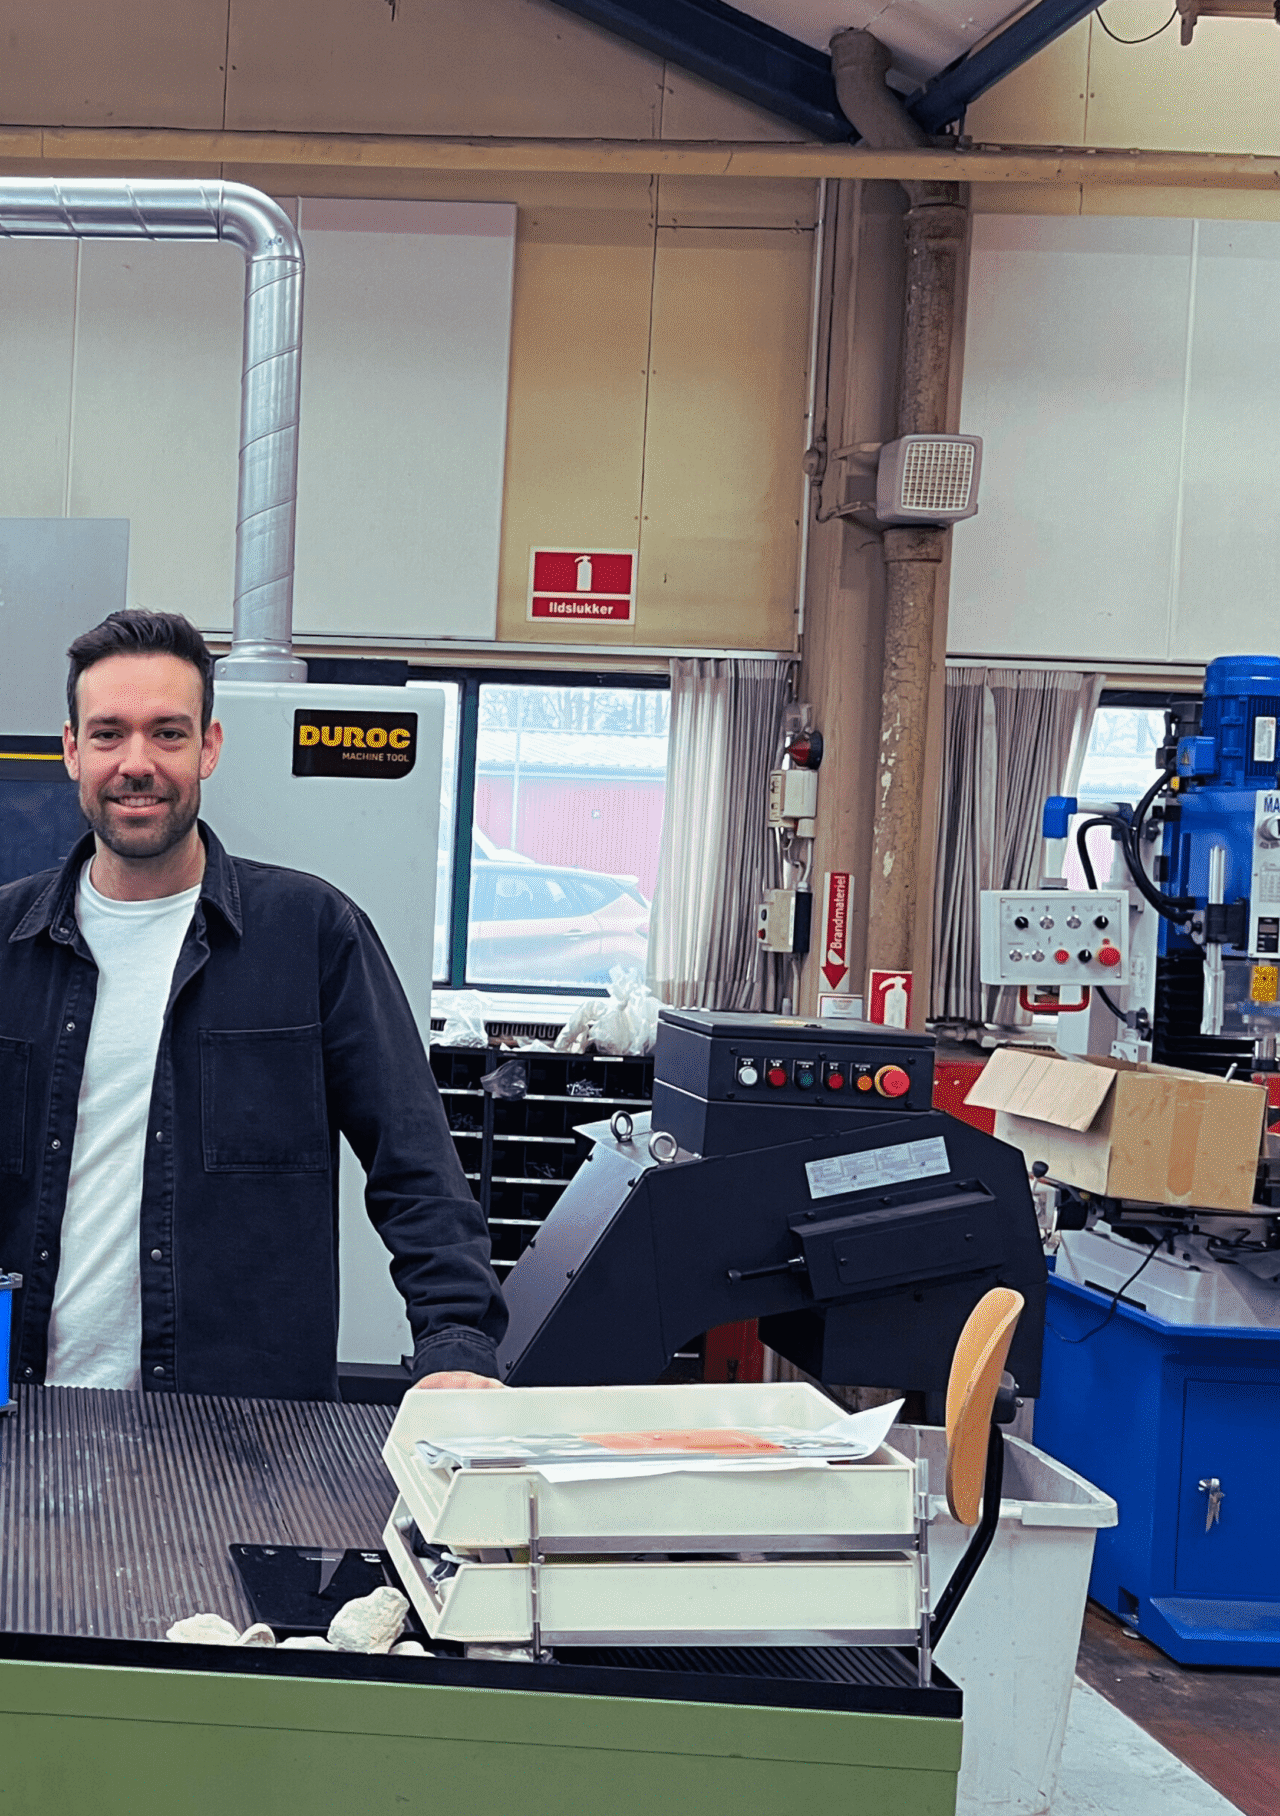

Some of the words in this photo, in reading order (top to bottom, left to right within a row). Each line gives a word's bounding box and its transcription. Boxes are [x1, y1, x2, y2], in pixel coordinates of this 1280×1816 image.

[549, 602, 614, 615] Ildslukker
[299, 725, 411, 749] DUROC
[342, 752, 384, 762] MACHINE
[386, 753, 410, 762] TOOL
[830, 875, 846, 949] Brandmateriel
